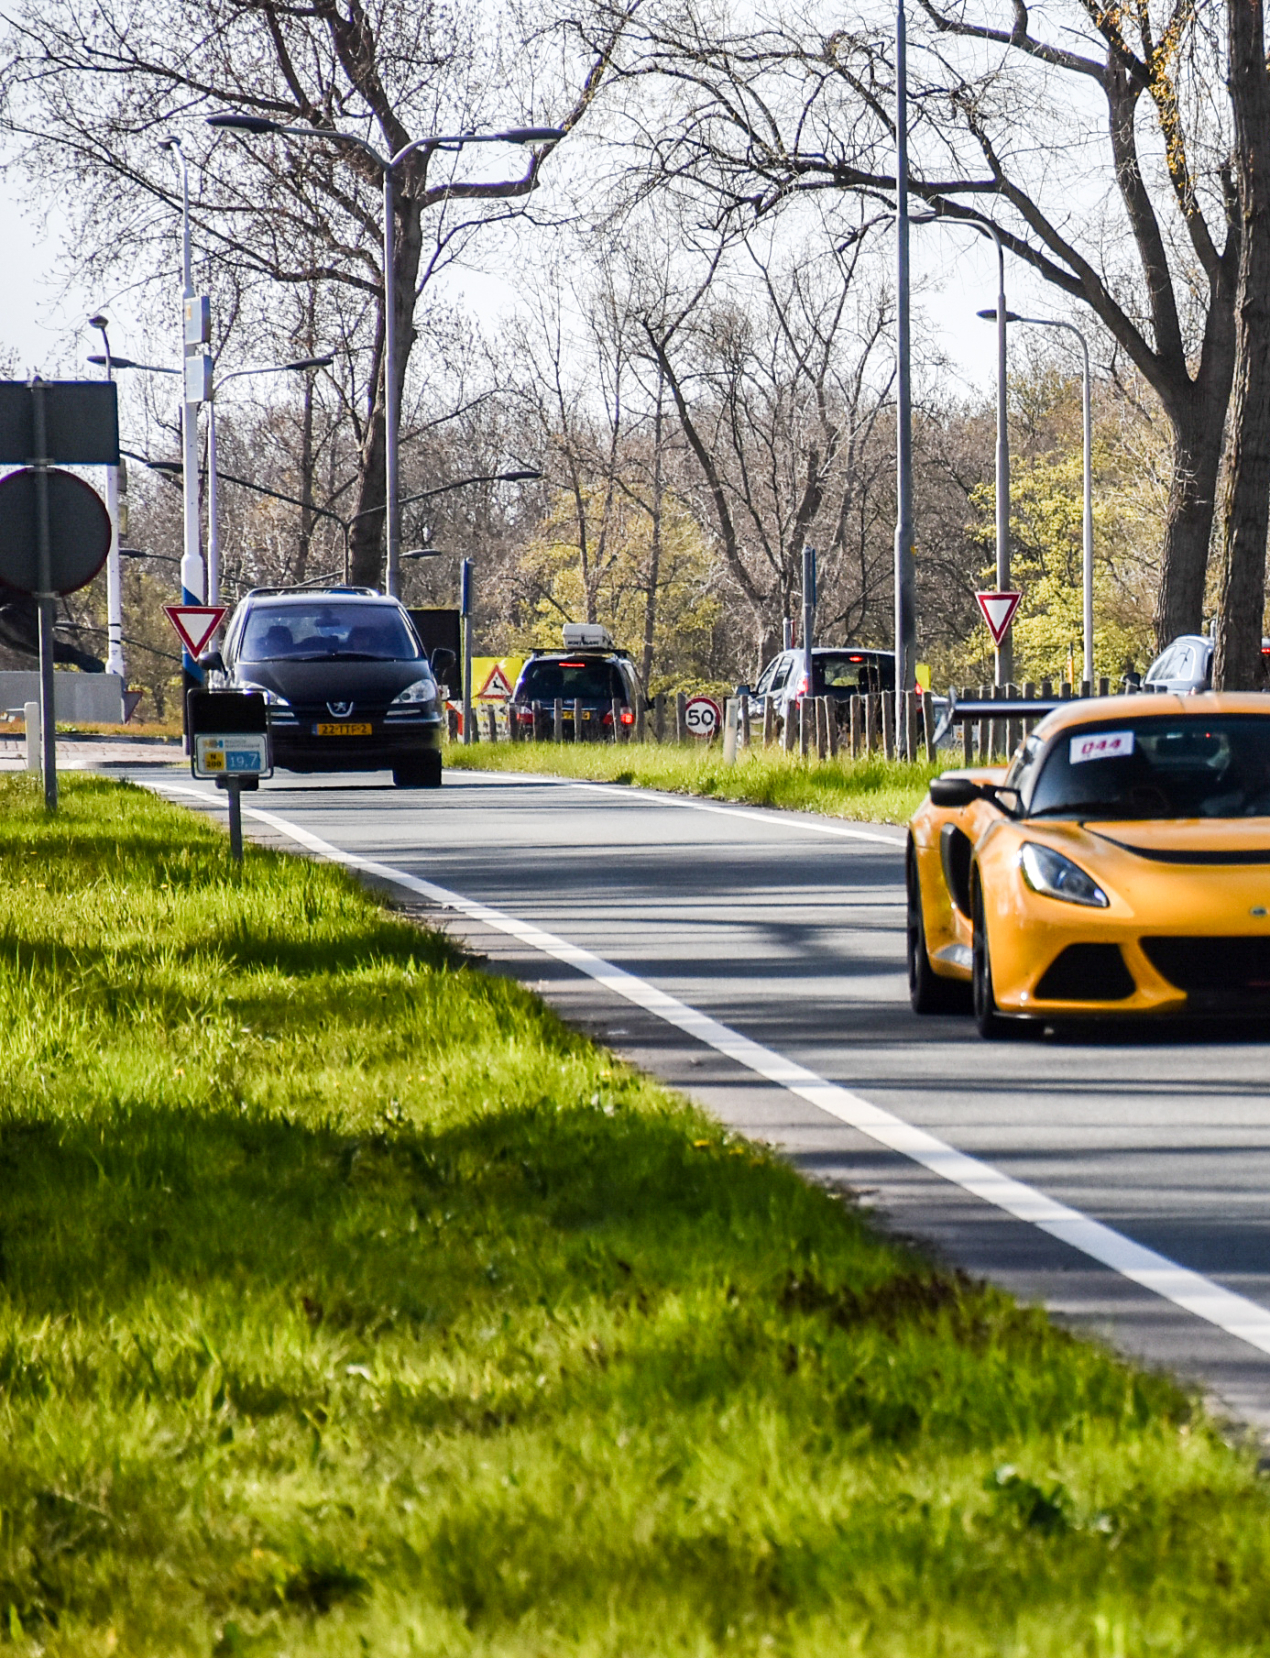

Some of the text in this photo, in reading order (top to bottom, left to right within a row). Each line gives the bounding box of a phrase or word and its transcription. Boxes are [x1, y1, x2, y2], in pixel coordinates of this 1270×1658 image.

[688, 709, 714, 727] 50
[1081, 738, 1122, 755] 044
[206, 761, 222, 769] 200
